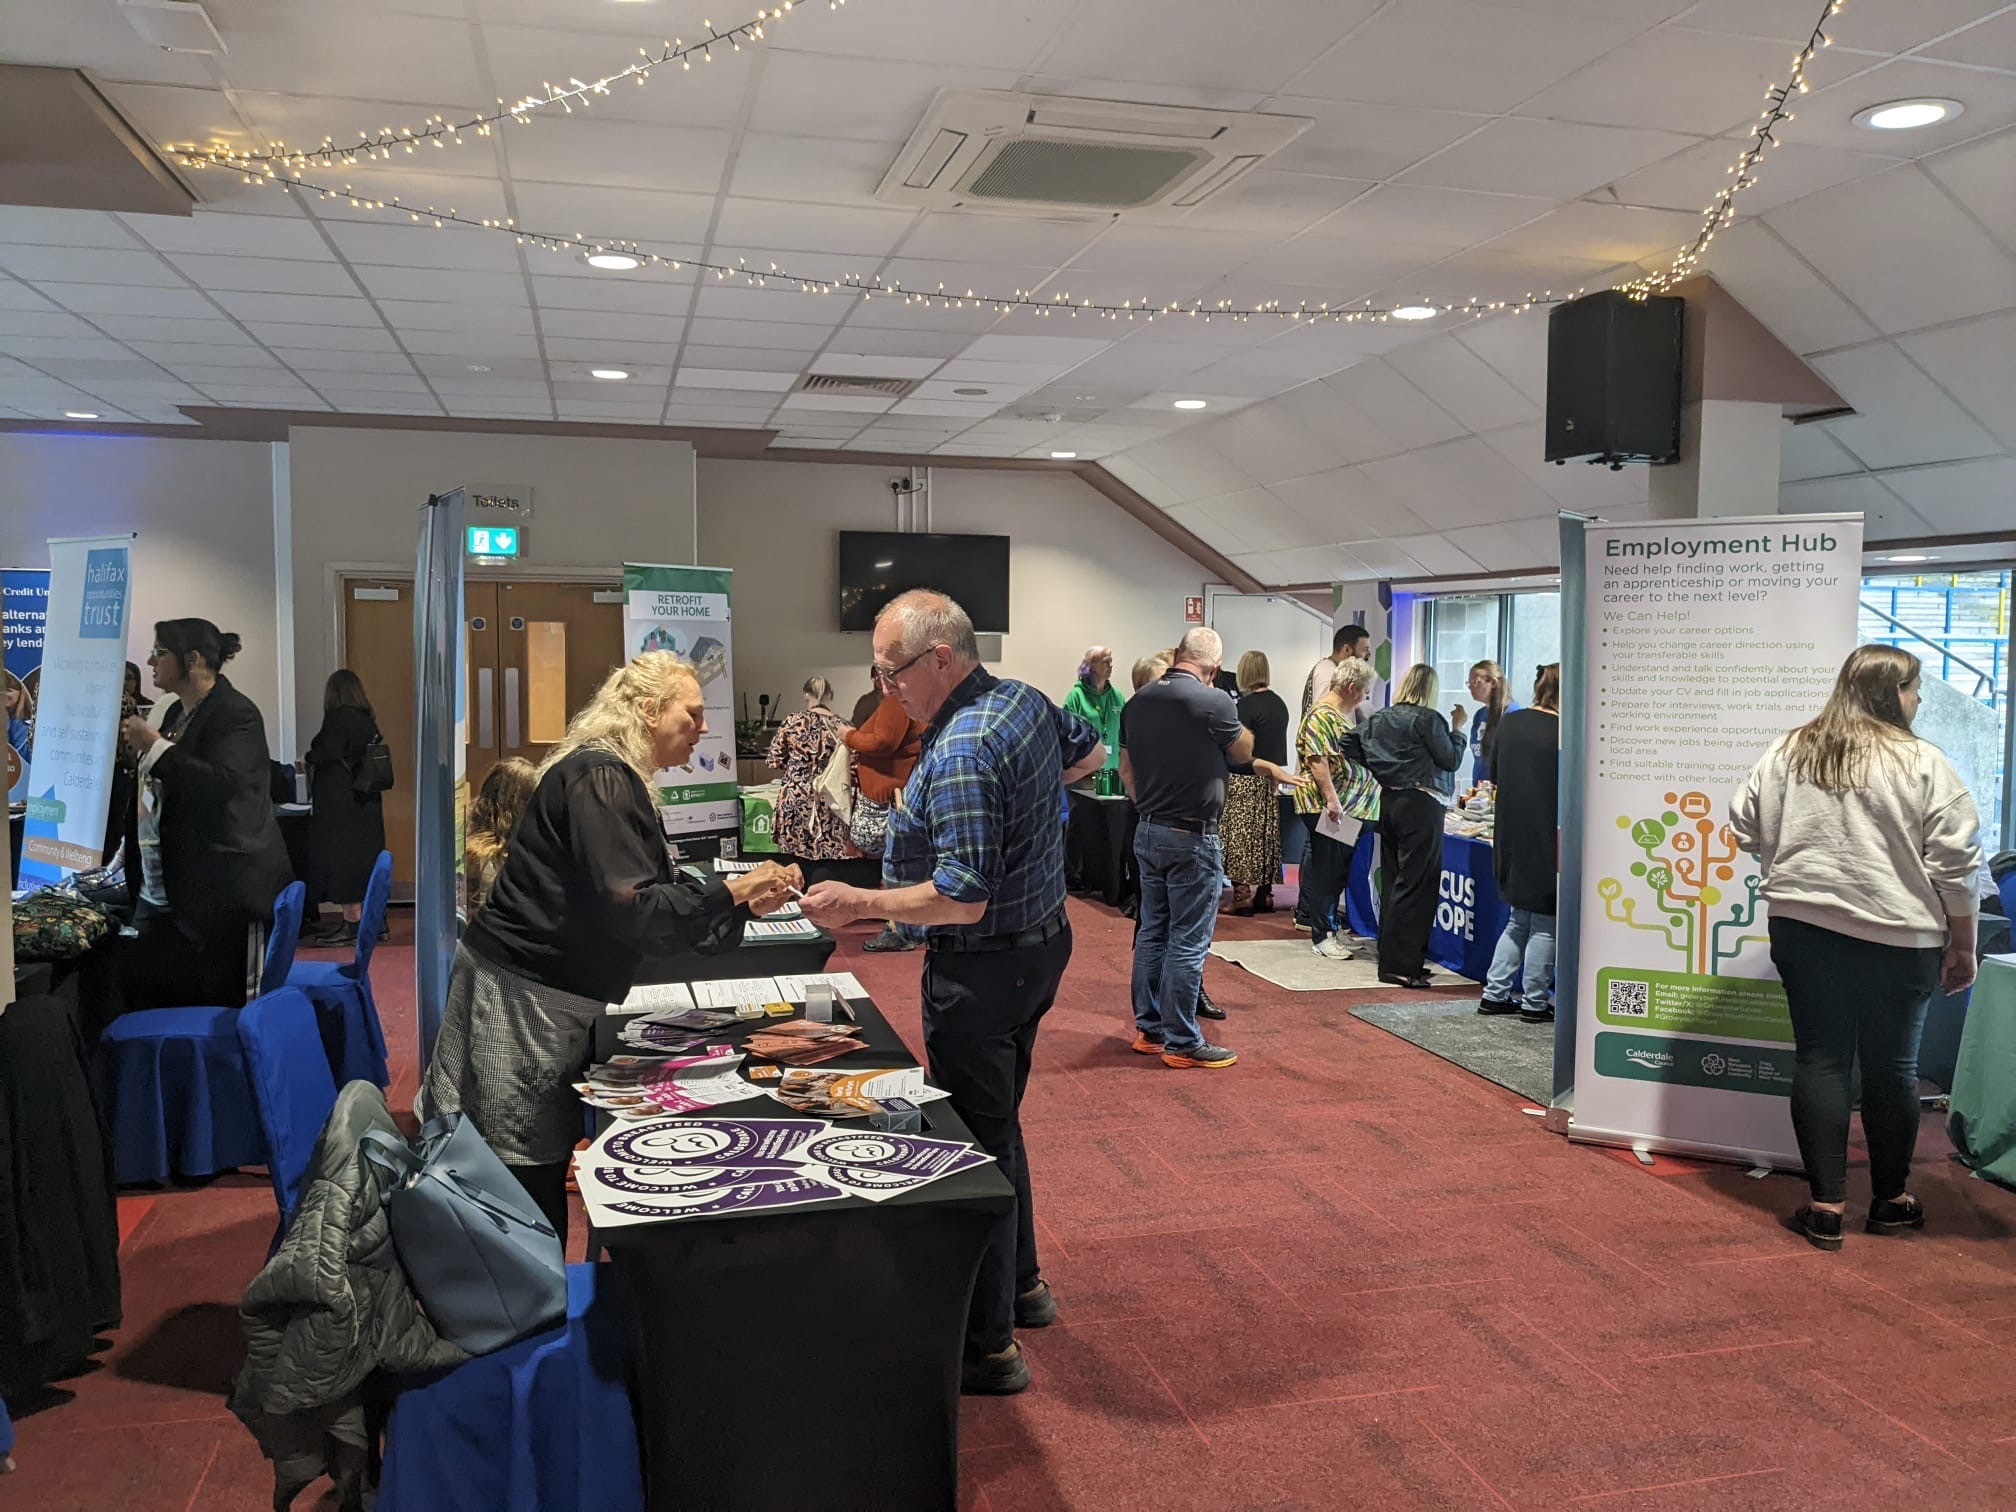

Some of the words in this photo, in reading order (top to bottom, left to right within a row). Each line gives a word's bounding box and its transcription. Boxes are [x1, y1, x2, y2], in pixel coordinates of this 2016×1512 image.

[472, 494, 520, 508] Toilets
[1606, 536, 1772, 559] Employment
[1782, 533, 1837, 553] Hub
[87, 561, 126, 583] halifax
[1604, 564, 1639, 576] Need
[1643, 563, 1672, 576] help
[1676, 562, 1724, 575] finding
[1729, 562, 1767, 573] work,
[1772, 560, 1825, 574] getting
[1603, 580, 1619, 590] an
[1623, 577, 1724, 590] apprenticeship
[1728, 578, 1744, 587] or
[1748, 576, 1801, 588] moving
[1806, 576, 1839, 588] your
[3, 587, 33, 597] Credit
[36, 587, 50, 597] Un
[1603, 594, 1644, 603] career
[1649, 592, 1663, 602] to
[1667, 592, 1689, 602] the
[1693, 592, 1723, 602] next
[1728, 590, 1768, 601] level?
[657, 594, 703, 606] RETROFIT
[2, 609, 47, 620] alterna
[83, 602, 120, 626] trust
[651, 605, 680, 616] YOUR
[681, 606, 711, 617] HOME
[1603, 611, 1624, 621] We
[1627, 611, 1652, 621] Can
[1656, 611, 1690, 622] Help!
[2, 624, 33, 634] anks
[35, 626, 47, 634] an
[1613, 626, 1650, 635] Explore
[1653, 627, 1676, 635] your
[1714, 625, 1755, 635] options
[3, 639, 14, 650] ey
[17, 637, 46, 648] lend
[1612, 641, 1635, 649] Help
[1639, 641, 1657, 650] you
[1660, 641, 1697, 650] change
[1735, 641, 1783, 649] direction
[1786, 641, 1815, 651] using
[1612, 651, 1634, 659] your
[1637, 651, 1697, 659] transferable
[1700, 651, 1725, 659] skills
[1612, 664, 1669, 673] Understand
[1672, 664, 1691, 672] and
[1694, 664, 1712, 673] talk
[1715, 664, 1774, 674] confidently
[1777, 664, 1808, 674] about
[1811, 666, 1836, 675] your
[1611, 674, 1634, 682] skills
[1638, 674, 1657, 682] and
[1659, 674, 1715, 684] knowledge
[1718, 676, 1730, 684] to
[1732, 675, 1779, 685] potential
[1782, 675, 1834, 686] employer
[1611, 687, 1648, 696] Update
[1651, 688, 1673, 696] your
[1676, 687, 1692, 695] CV
[1695, 688, 1714, 696] and
[1717, 687, 1729, 696] fill
[1732, 689, 1741, 697] in
[1744, 688, 1762, 698] job
[1764, 688, 1829, 699] applications
[1611, 700, 1650, 710] Prepare
[1652, 700, 1667, 709] for
[1670, 702, 1724, 711] interviews,
[1727, 702, 1753, 711] work
[1756, 703, 1781, 711] trials
[1785, 703, 1805, 712] and
[1611, 710, 1651, 720] working
[1653, 712, 1718, 720] environment
[1610, 723, 1632, 732] Find
[1635, 724, 1660, 732] work
[1663, 726, 1719, 735] experience
[1721, 726, 1790, 736] opportuniti
[1610, 736, 1652, 745] Discover
[1679, 738, 1701, 747] jobs
[1703, 738, 1733, 749] being
[1736, 738, 1769, 748] advert
[1610, 747, 1633, 755] local
[1609, 759, 1632, 768] Find
[1634, 760, 1674, 769] suitable
[1676, 761, 1715, 771] training
[1718, 763, 1754, 772] course
[1609, 771, 1651, 781] Connect
[1654, 773, 1676, 782] with
[1678, 774, 1706, 783] other
[1709, 774, 1733, 784] local
[27, 802, 59, 816] mployment
[1438, 870, 1475, 908] CUS
[1433, 902, 1475, 942] OPE
[1655, 999, 1695, 1008] Twitter/X:
[1655, 1006, 1695, 1015] Facebook:
[1626, 1049, 1674, 1061] Calderdale
[617, 1121, 703, 1141] BREASTFEED
[731, 1169, 749, 1177] CA
[616, 1180, 698, 1192] WELCOME
[736, 1184, 756, 1200] CAL
[616, 1202, 701, 1214] WELCOME
